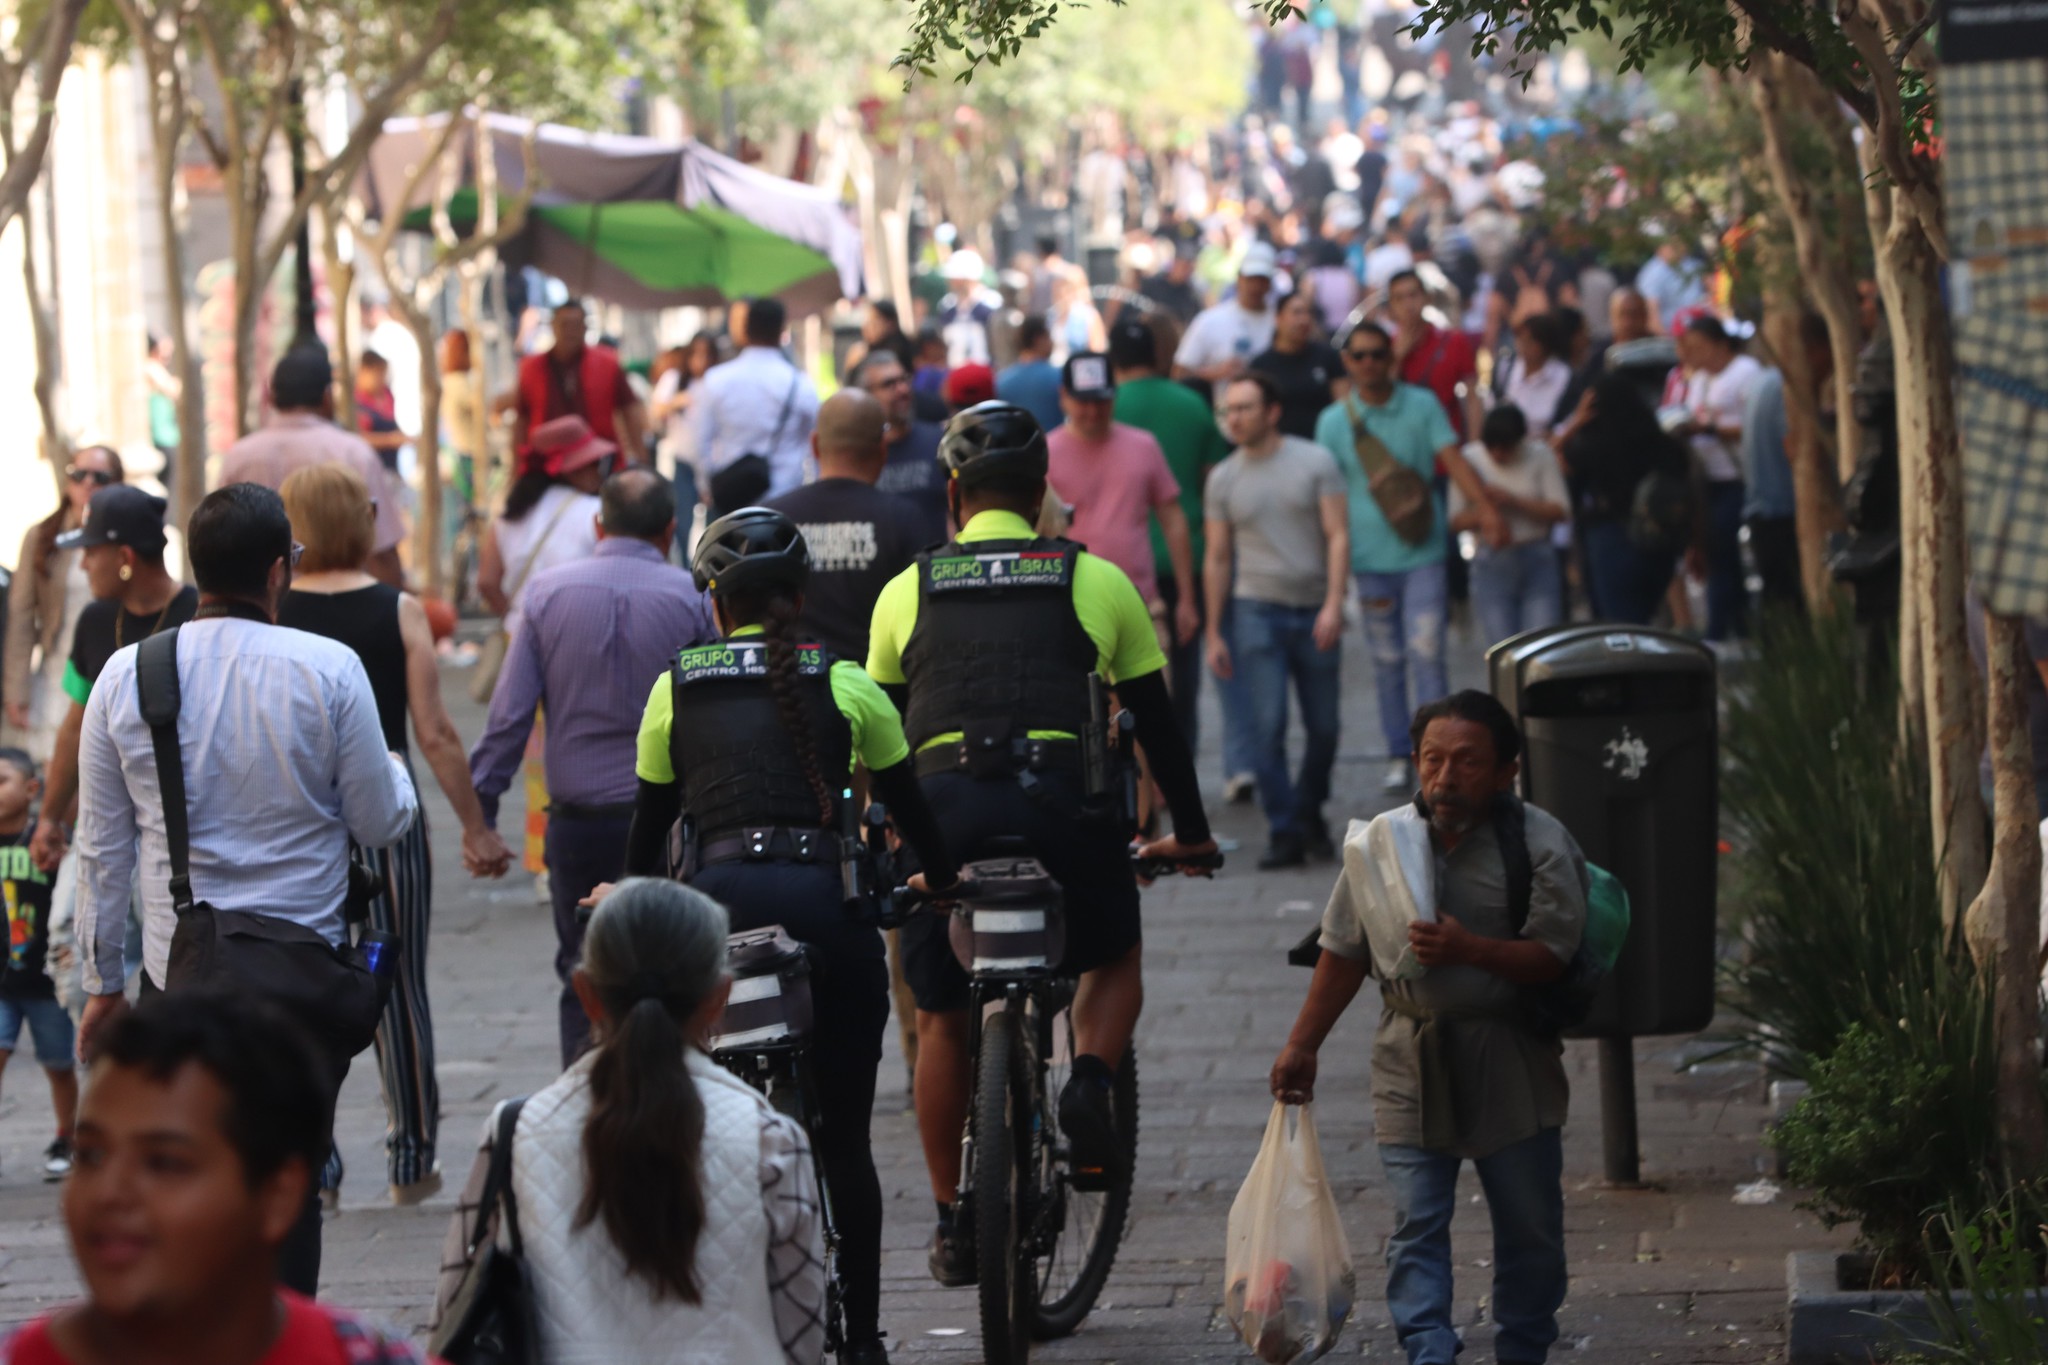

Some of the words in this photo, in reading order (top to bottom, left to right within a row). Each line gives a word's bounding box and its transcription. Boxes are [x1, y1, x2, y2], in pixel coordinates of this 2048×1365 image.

[931, 561, 982, 581] GRUPO
[1010, 558, 1063, 575] LIBRAS
[935, 577, 986, 590] CENTRO
[681, 650, 734, 671] GRUPO
[685, 666, 739, 681] CENTRO
